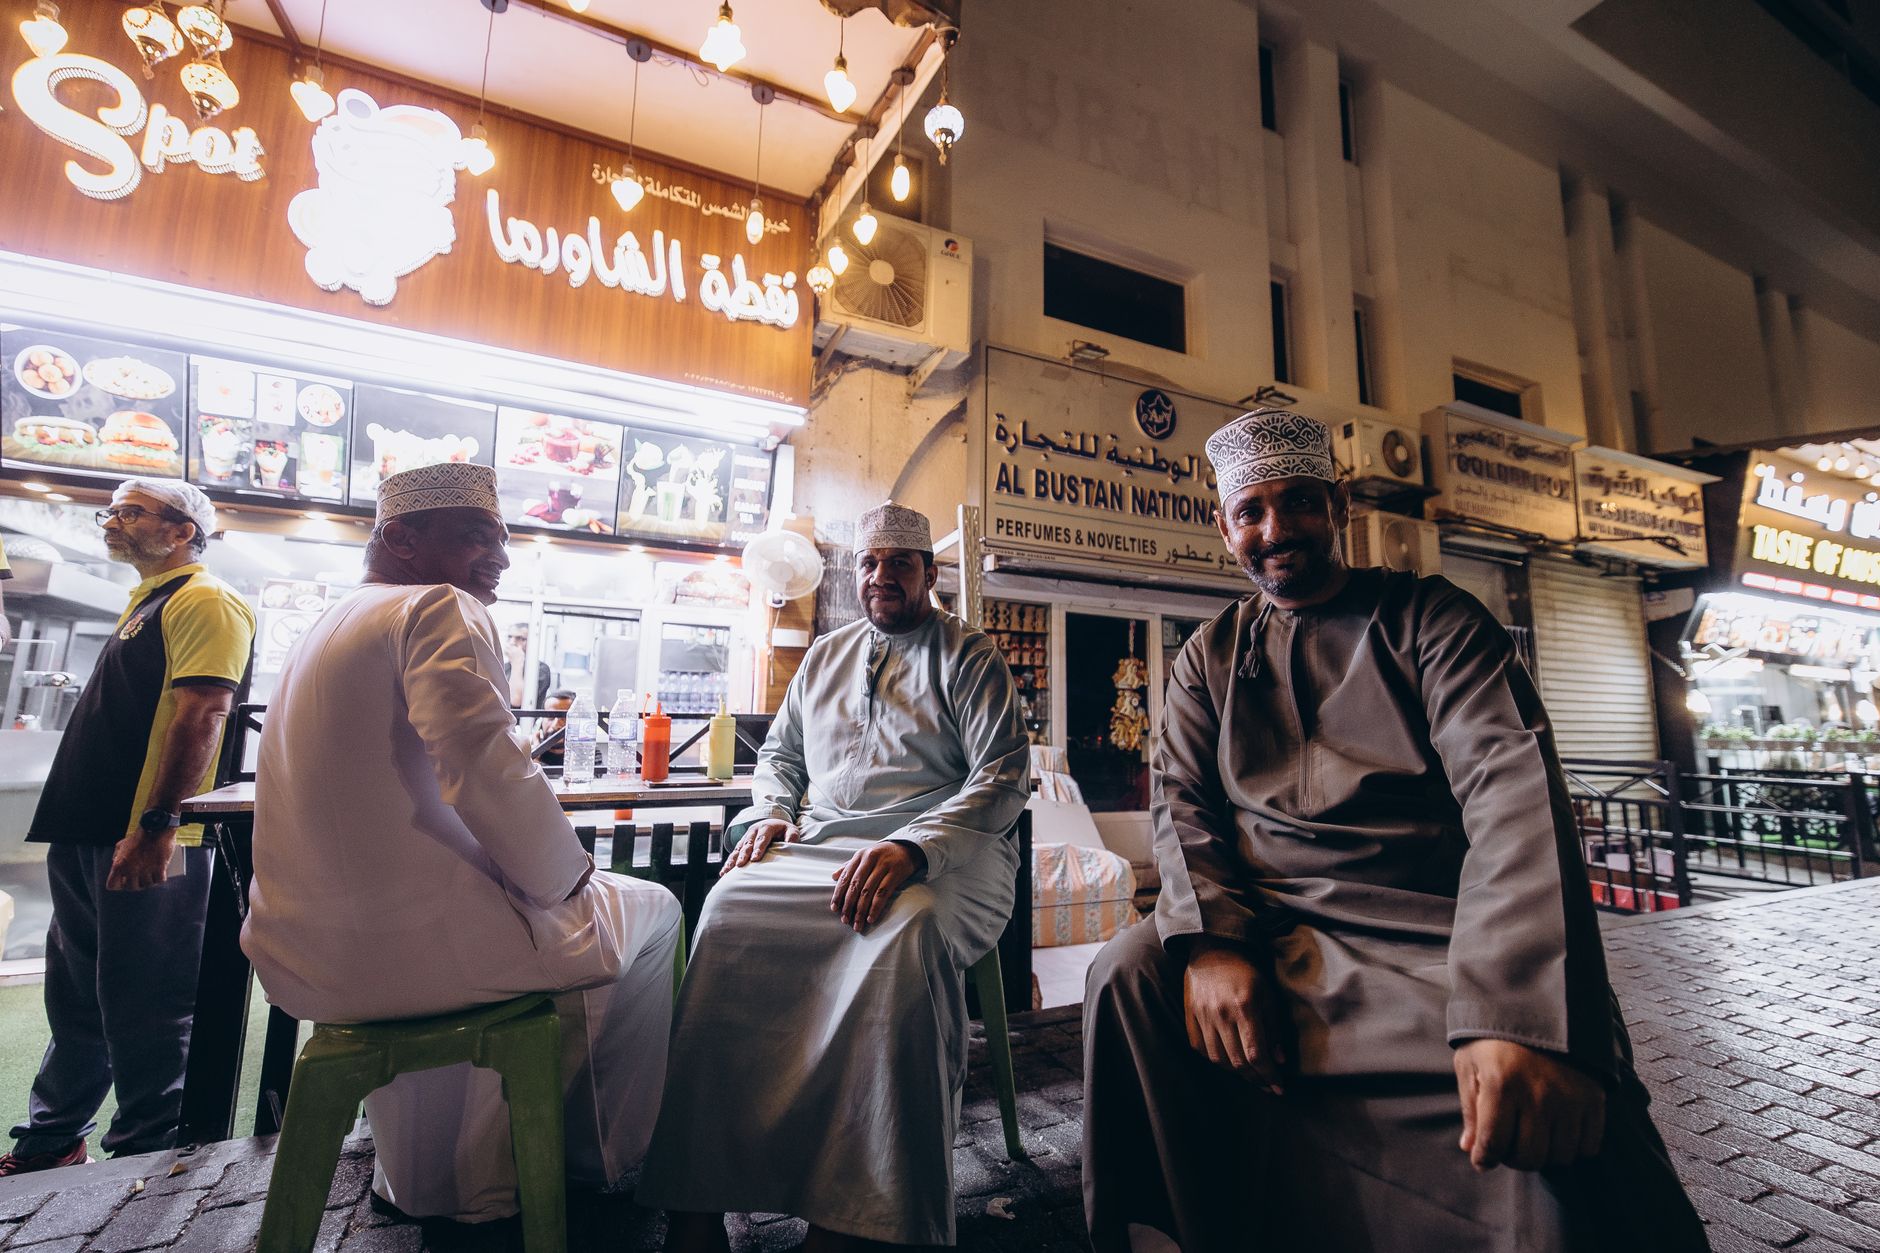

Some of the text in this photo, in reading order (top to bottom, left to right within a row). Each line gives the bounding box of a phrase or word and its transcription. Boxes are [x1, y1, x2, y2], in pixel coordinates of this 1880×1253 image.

[12, 53, 266, 200] Spot
[702, 202, 749, 221] الشمس
[487, 188, 799, 329] نقطة الشاورما
[994, 413, 1098, 461] للتجارة
[1106, 432, 1198, 483] الوطنية
[995, 462, 1218, 528] AL BUSTAN NATIONA
[996, 518, 1157, 555] PERFUMES & NOVELTIES
[1165, 544, 1213, 564] عطور
[1752, 524, 1880, 586] TASTE OF MUS
